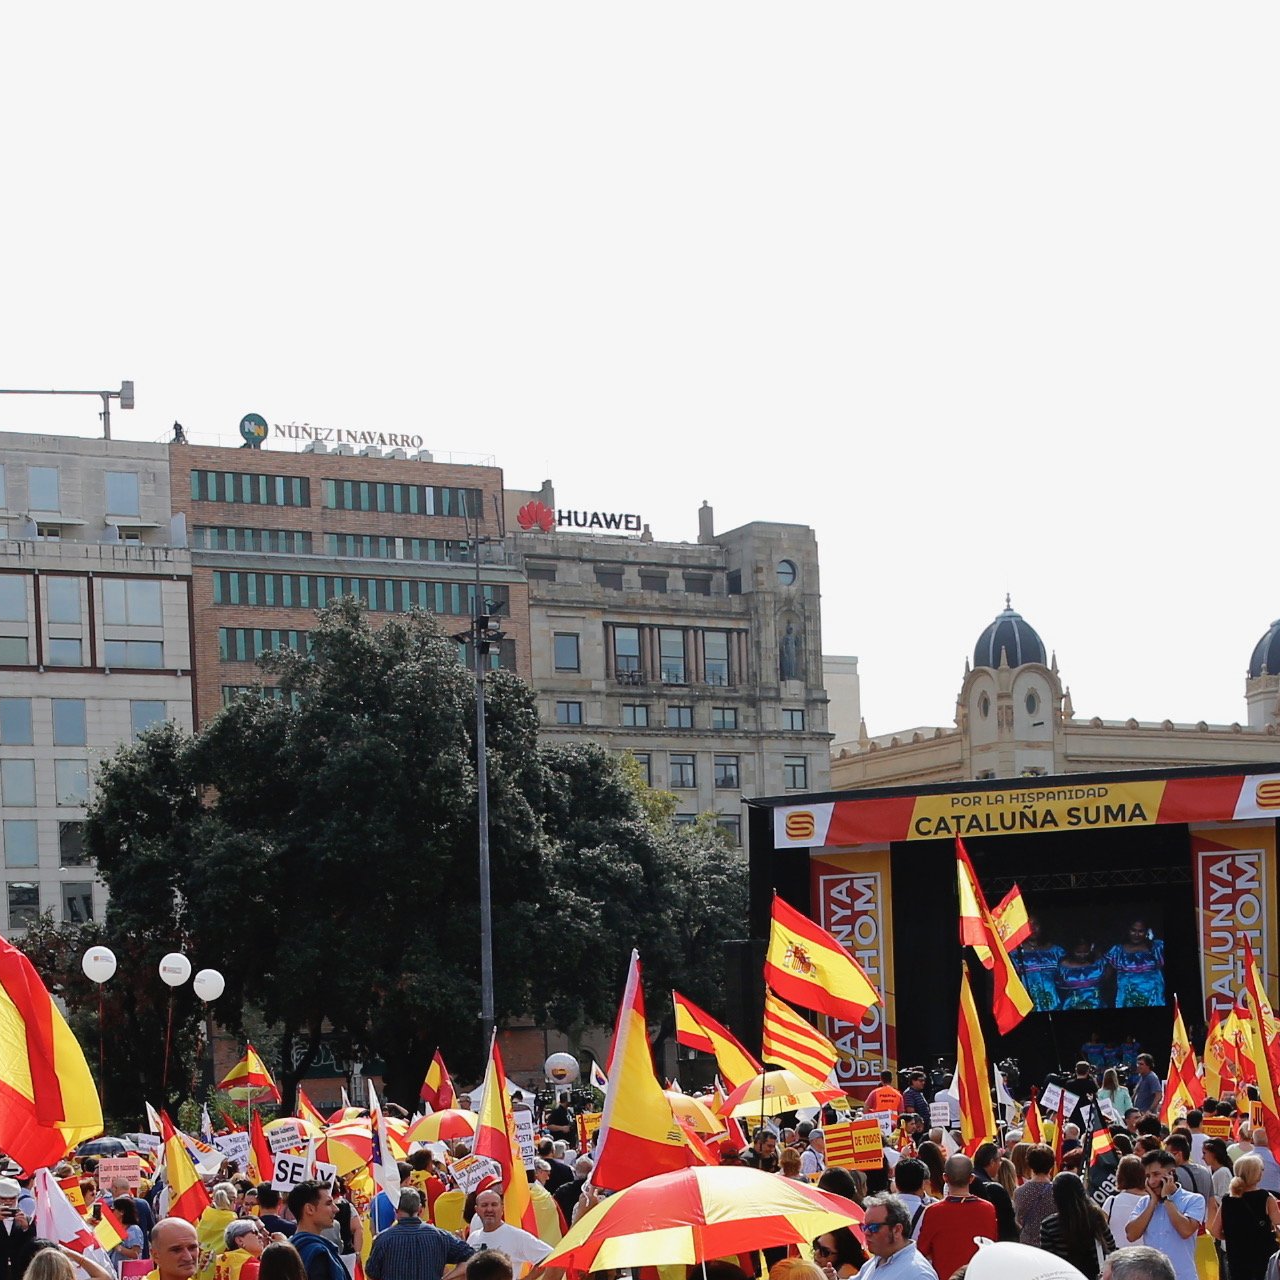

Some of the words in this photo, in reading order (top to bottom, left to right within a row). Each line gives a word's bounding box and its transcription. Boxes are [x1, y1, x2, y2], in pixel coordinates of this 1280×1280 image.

[274, 421, 334, 442] NÚÑEZ
[346, 429, 424, 448] NAVARRO
[557, 508, 642, 532] HUAWEI
[951, 796, 982, 808] POR
[986, 794, 1005, 806] LA
[1009, 787, 1109, 804] HISPANIDAD
[915, 804, 1059, 836] CATALUÑA
[1067, 803, 1147, 826] SUMA
[856, 1060, 882, 1077] DE
[854, 1136, 863, 1147] DE
[863, 1133, 881, 1145] TODOS
[275, 1159, 305, 1184] SE
